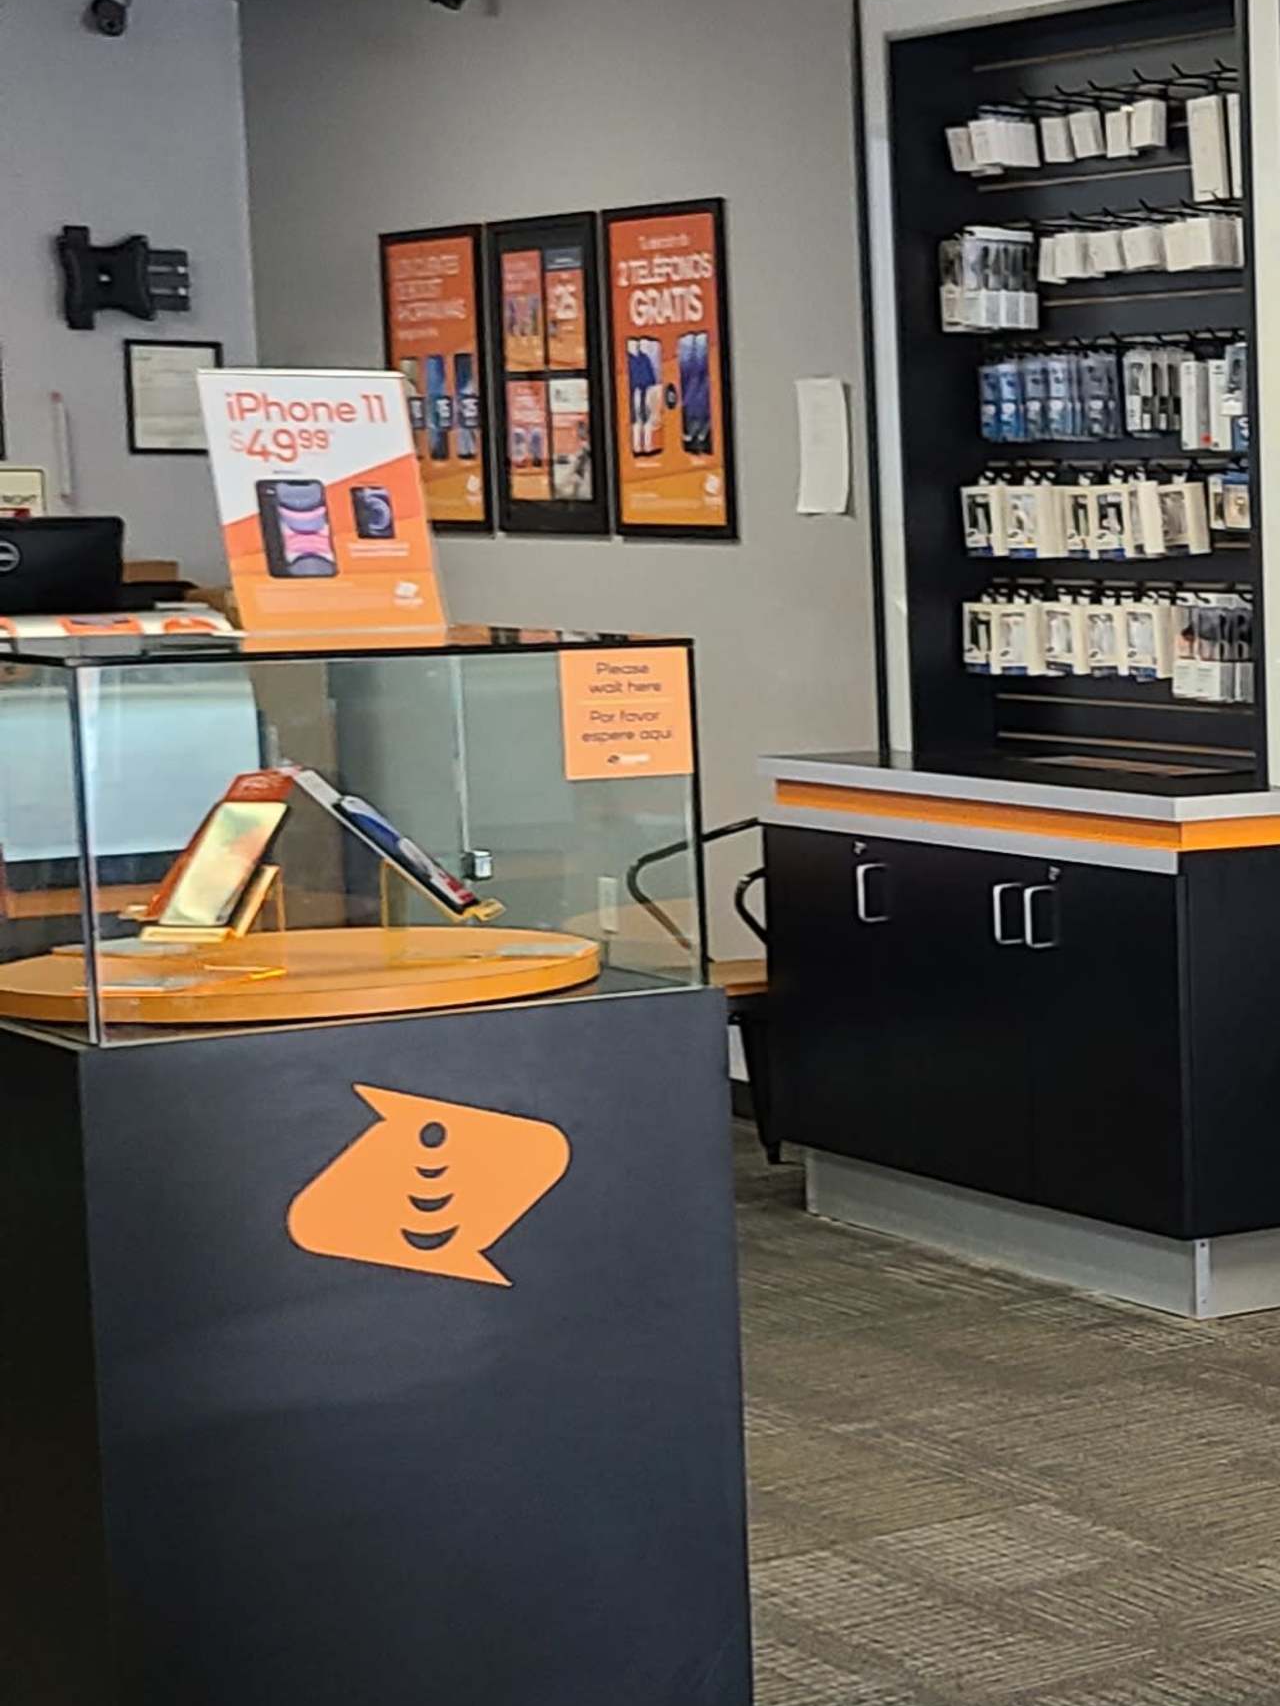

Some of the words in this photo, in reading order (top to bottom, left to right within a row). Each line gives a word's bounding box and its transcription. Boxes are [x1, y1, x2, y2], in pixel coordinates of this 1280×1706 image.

[629, 283, 704, 327] GRATIS
[225, 391, 357, 423] iPhone
[361, 394, 388, 424] 11
[595, 661, 650, 675] Please
[587, 680, 623, 694] wait
[627, 680, 662, 693] here
[619, 709, 661, 723] favor
[581, 730, 636, 743] espere
